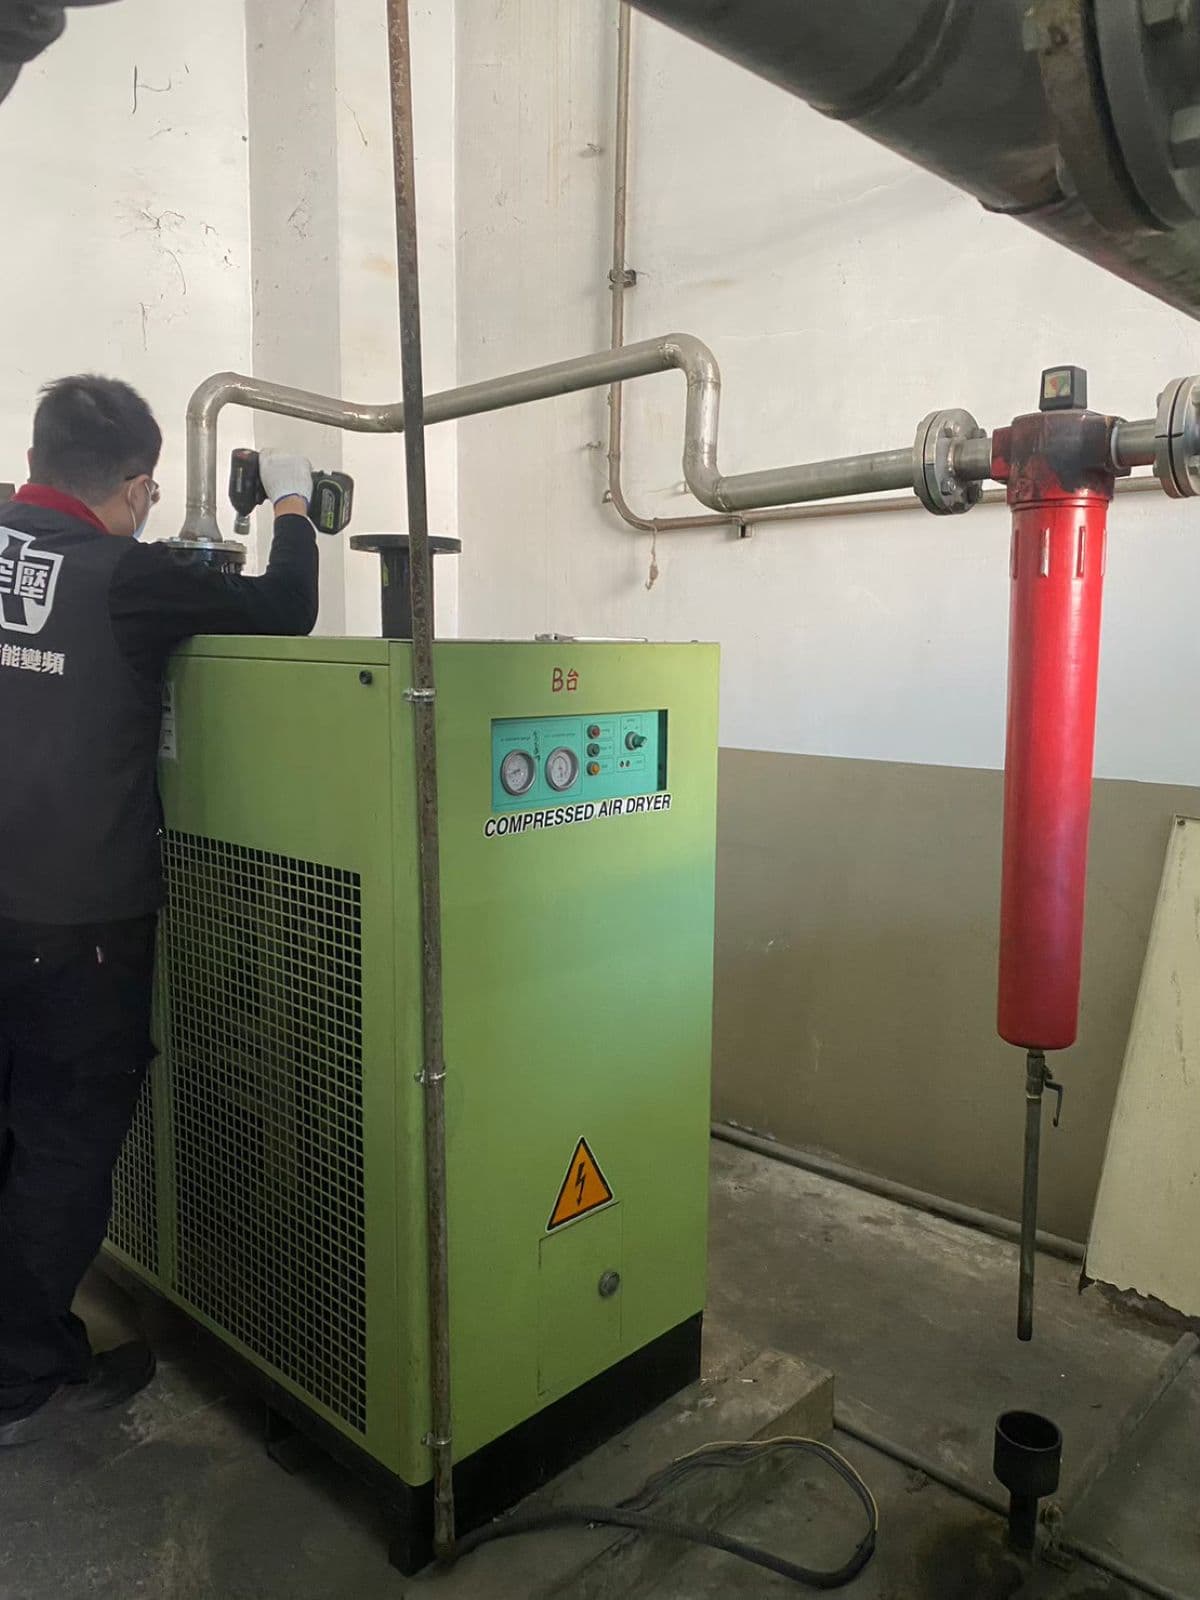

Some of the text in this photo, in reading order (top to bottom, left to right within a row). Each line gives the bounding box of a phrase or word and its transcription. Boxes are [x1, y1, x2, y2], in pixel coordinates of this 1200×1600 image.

[0, 644, 65, 675] 能變頻
[485, 795, 671, 837] COMPRESSED AIR DRYER
